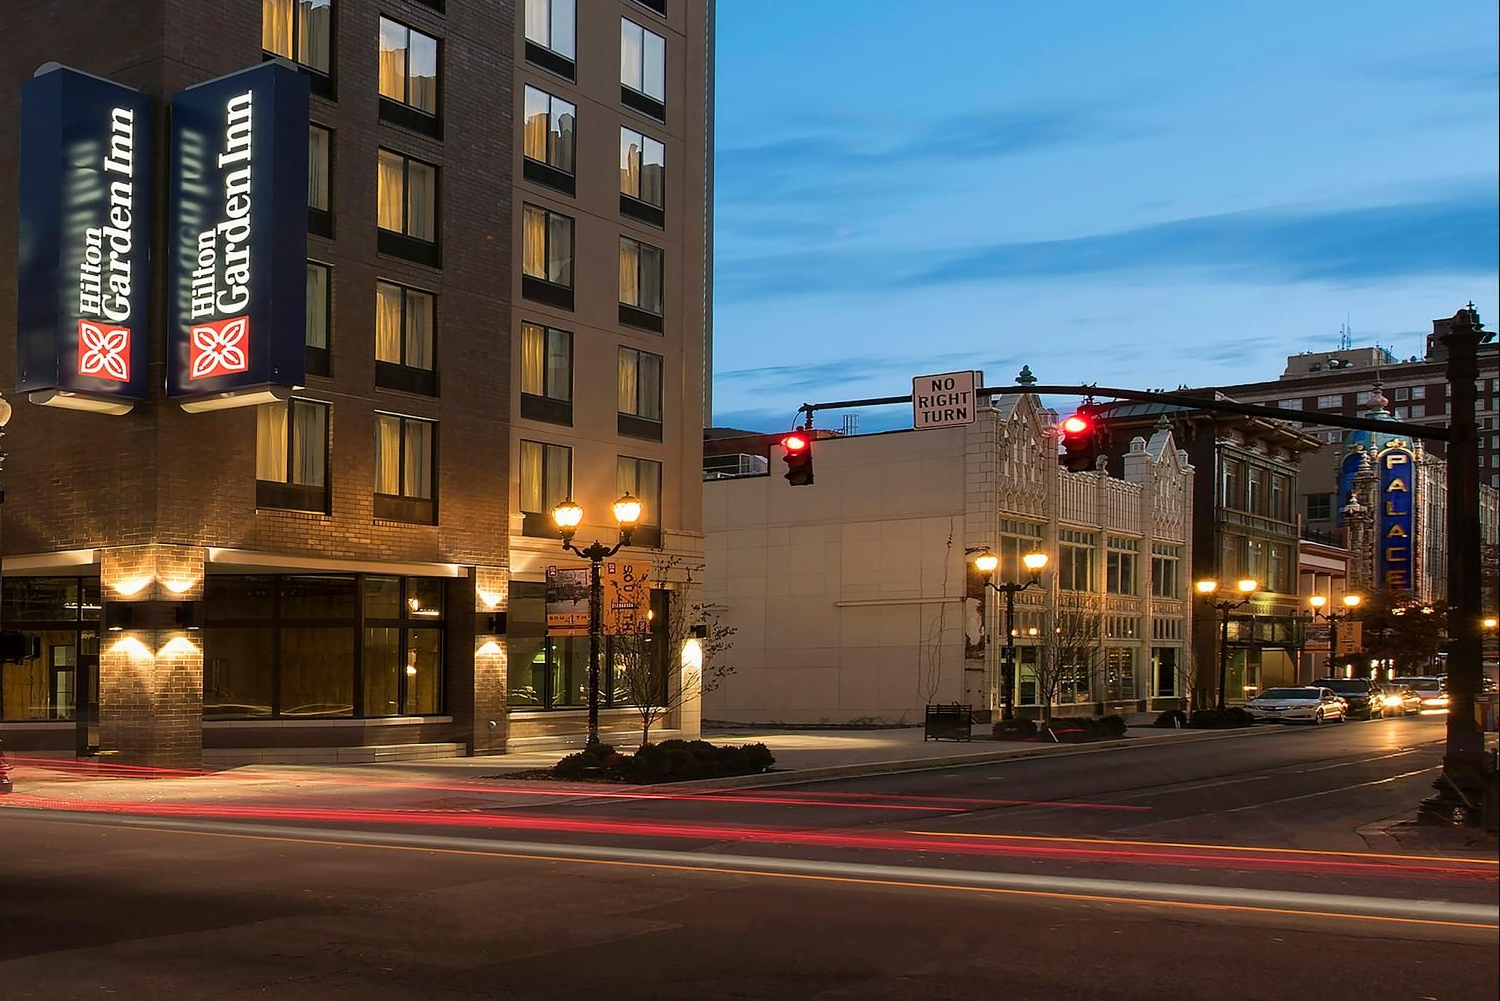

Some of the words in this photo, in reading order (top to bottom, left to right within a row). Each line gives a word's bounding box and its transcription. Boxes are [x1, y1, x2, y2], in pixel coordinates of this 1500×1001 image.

[104, 106, 134, 178] Inn
[218, 90, 254, 168] Inn
[79, 226, 102, 316] Hilton
[100, 180, 134, 322] Garden
[191, 228, 219, 320] Hilton
[215, 165, 252, 314] Garden
[918, 391, 971, 408] RIGHT
[922, 407, 967, 423] TURN
[931, 377, 955, 392] NO
[1386, 454, 1408, 587] PALACE
